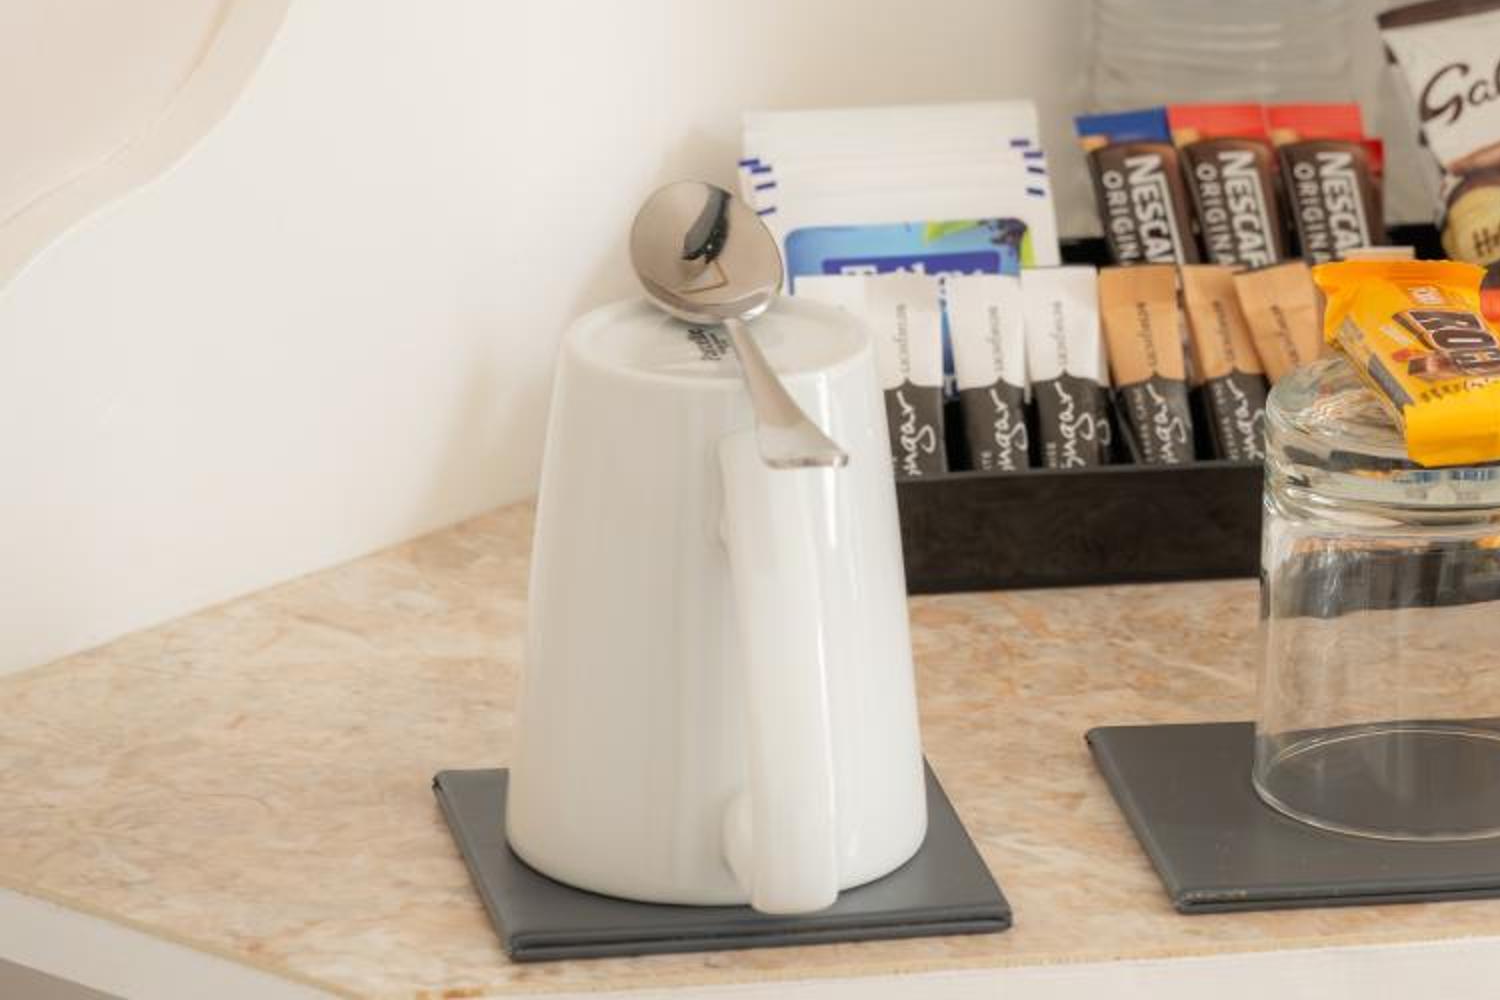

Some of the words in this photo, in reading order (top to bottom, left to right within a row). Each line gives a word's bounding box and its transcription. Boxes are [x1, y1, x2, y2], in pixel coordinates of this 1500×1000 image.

[1101, 170, 1141, 265] ORIGIN
[1124, 152, 1184, 265] NESCA
[1195, 162, 1237, 265] ORIGINA
[1217, 150, 1278, 268] NESCAF
[1315, 151, 1372, 259] NESCA
[896, 390, 936, 476] ugar
